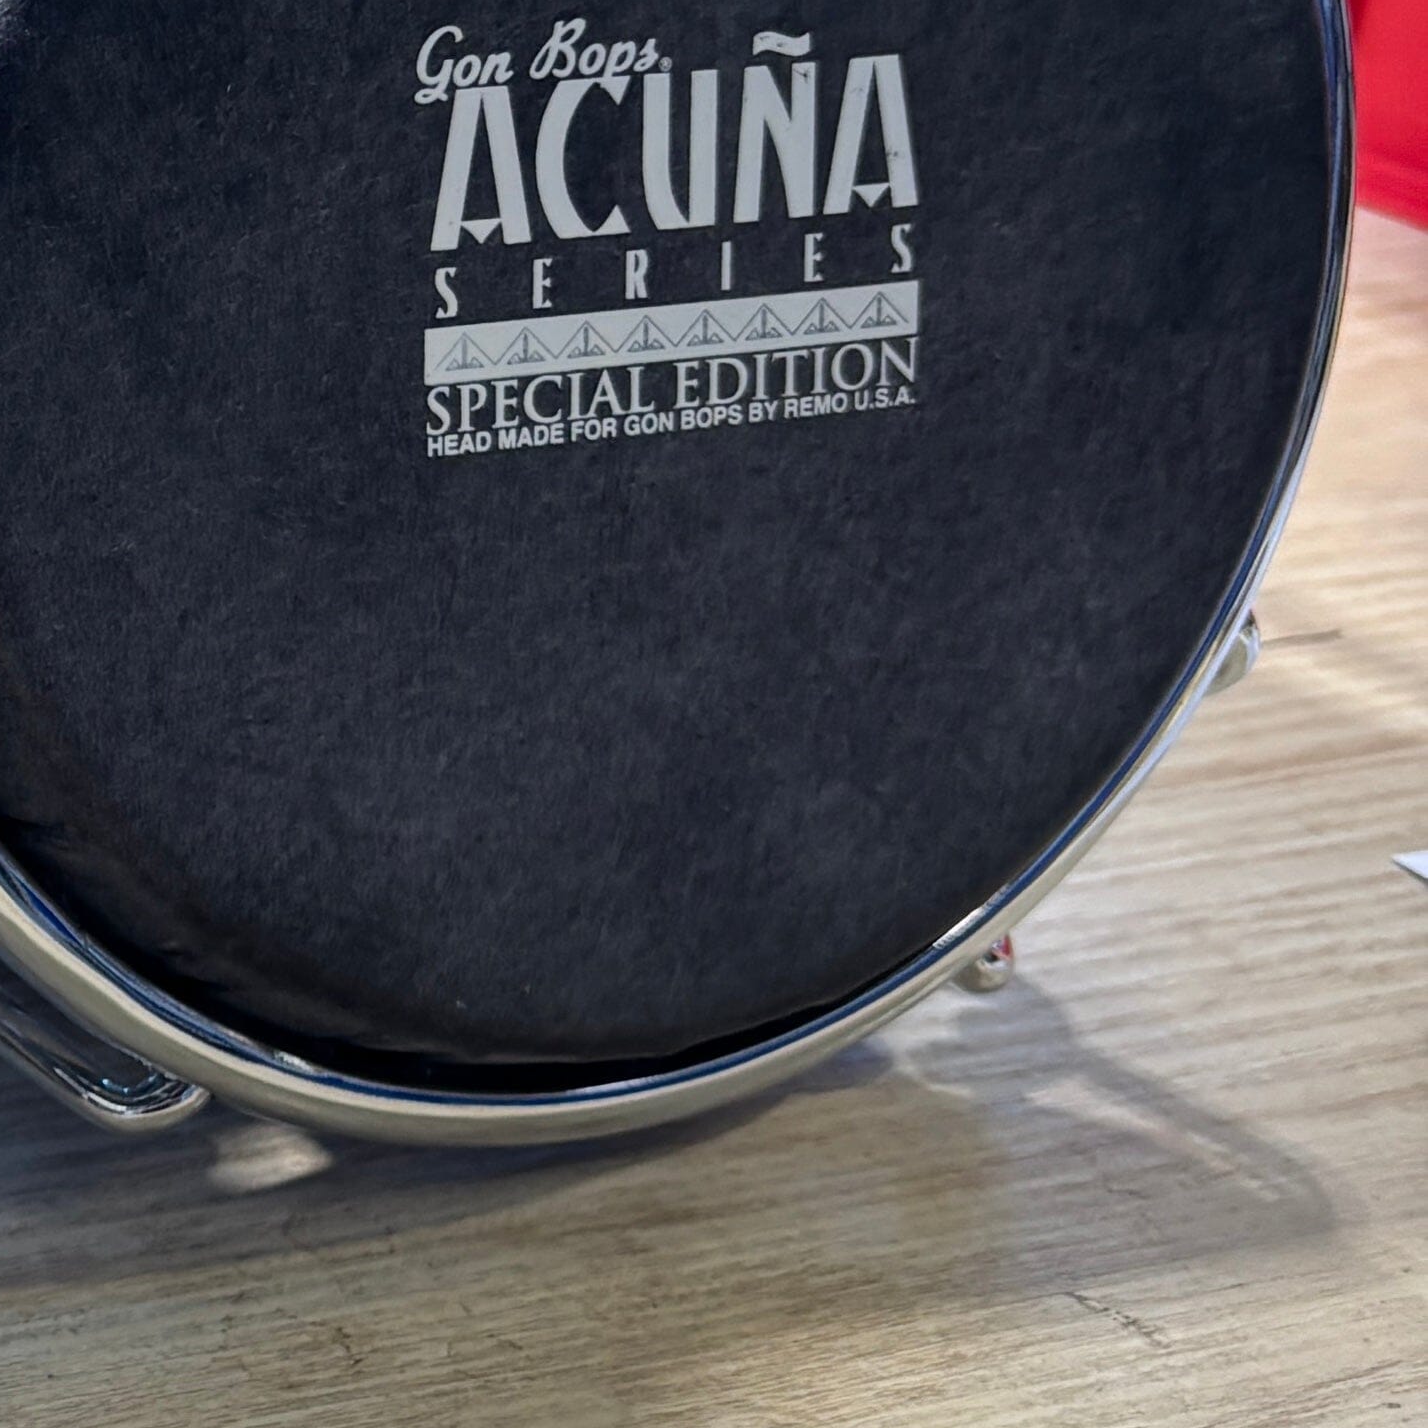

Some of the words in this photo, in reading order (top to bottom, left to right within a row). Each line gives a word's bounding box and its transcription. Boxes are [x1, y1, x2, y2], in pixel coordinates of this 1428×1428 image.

[415, 26, 514, 103] Gon
[431, 32, 918, 251] ACUÑA
[435, 224, 912, 318] SERIES
[426, 367, 655, 436] SPECIAL
[674, 338, 918, 409] EDITION
[428, 431, 492, 457] HEAD
[498, 423, 565, 450] MADE
[571, 418, 617, 442] FOR
[624, 411, 674, 436] GON
[680, 405, 743, 430] BOPS
[748, 400, 778, 422] BY
[784, 393, 848, 419] REMO
[854, 386, 916, 411] U.S.A.
